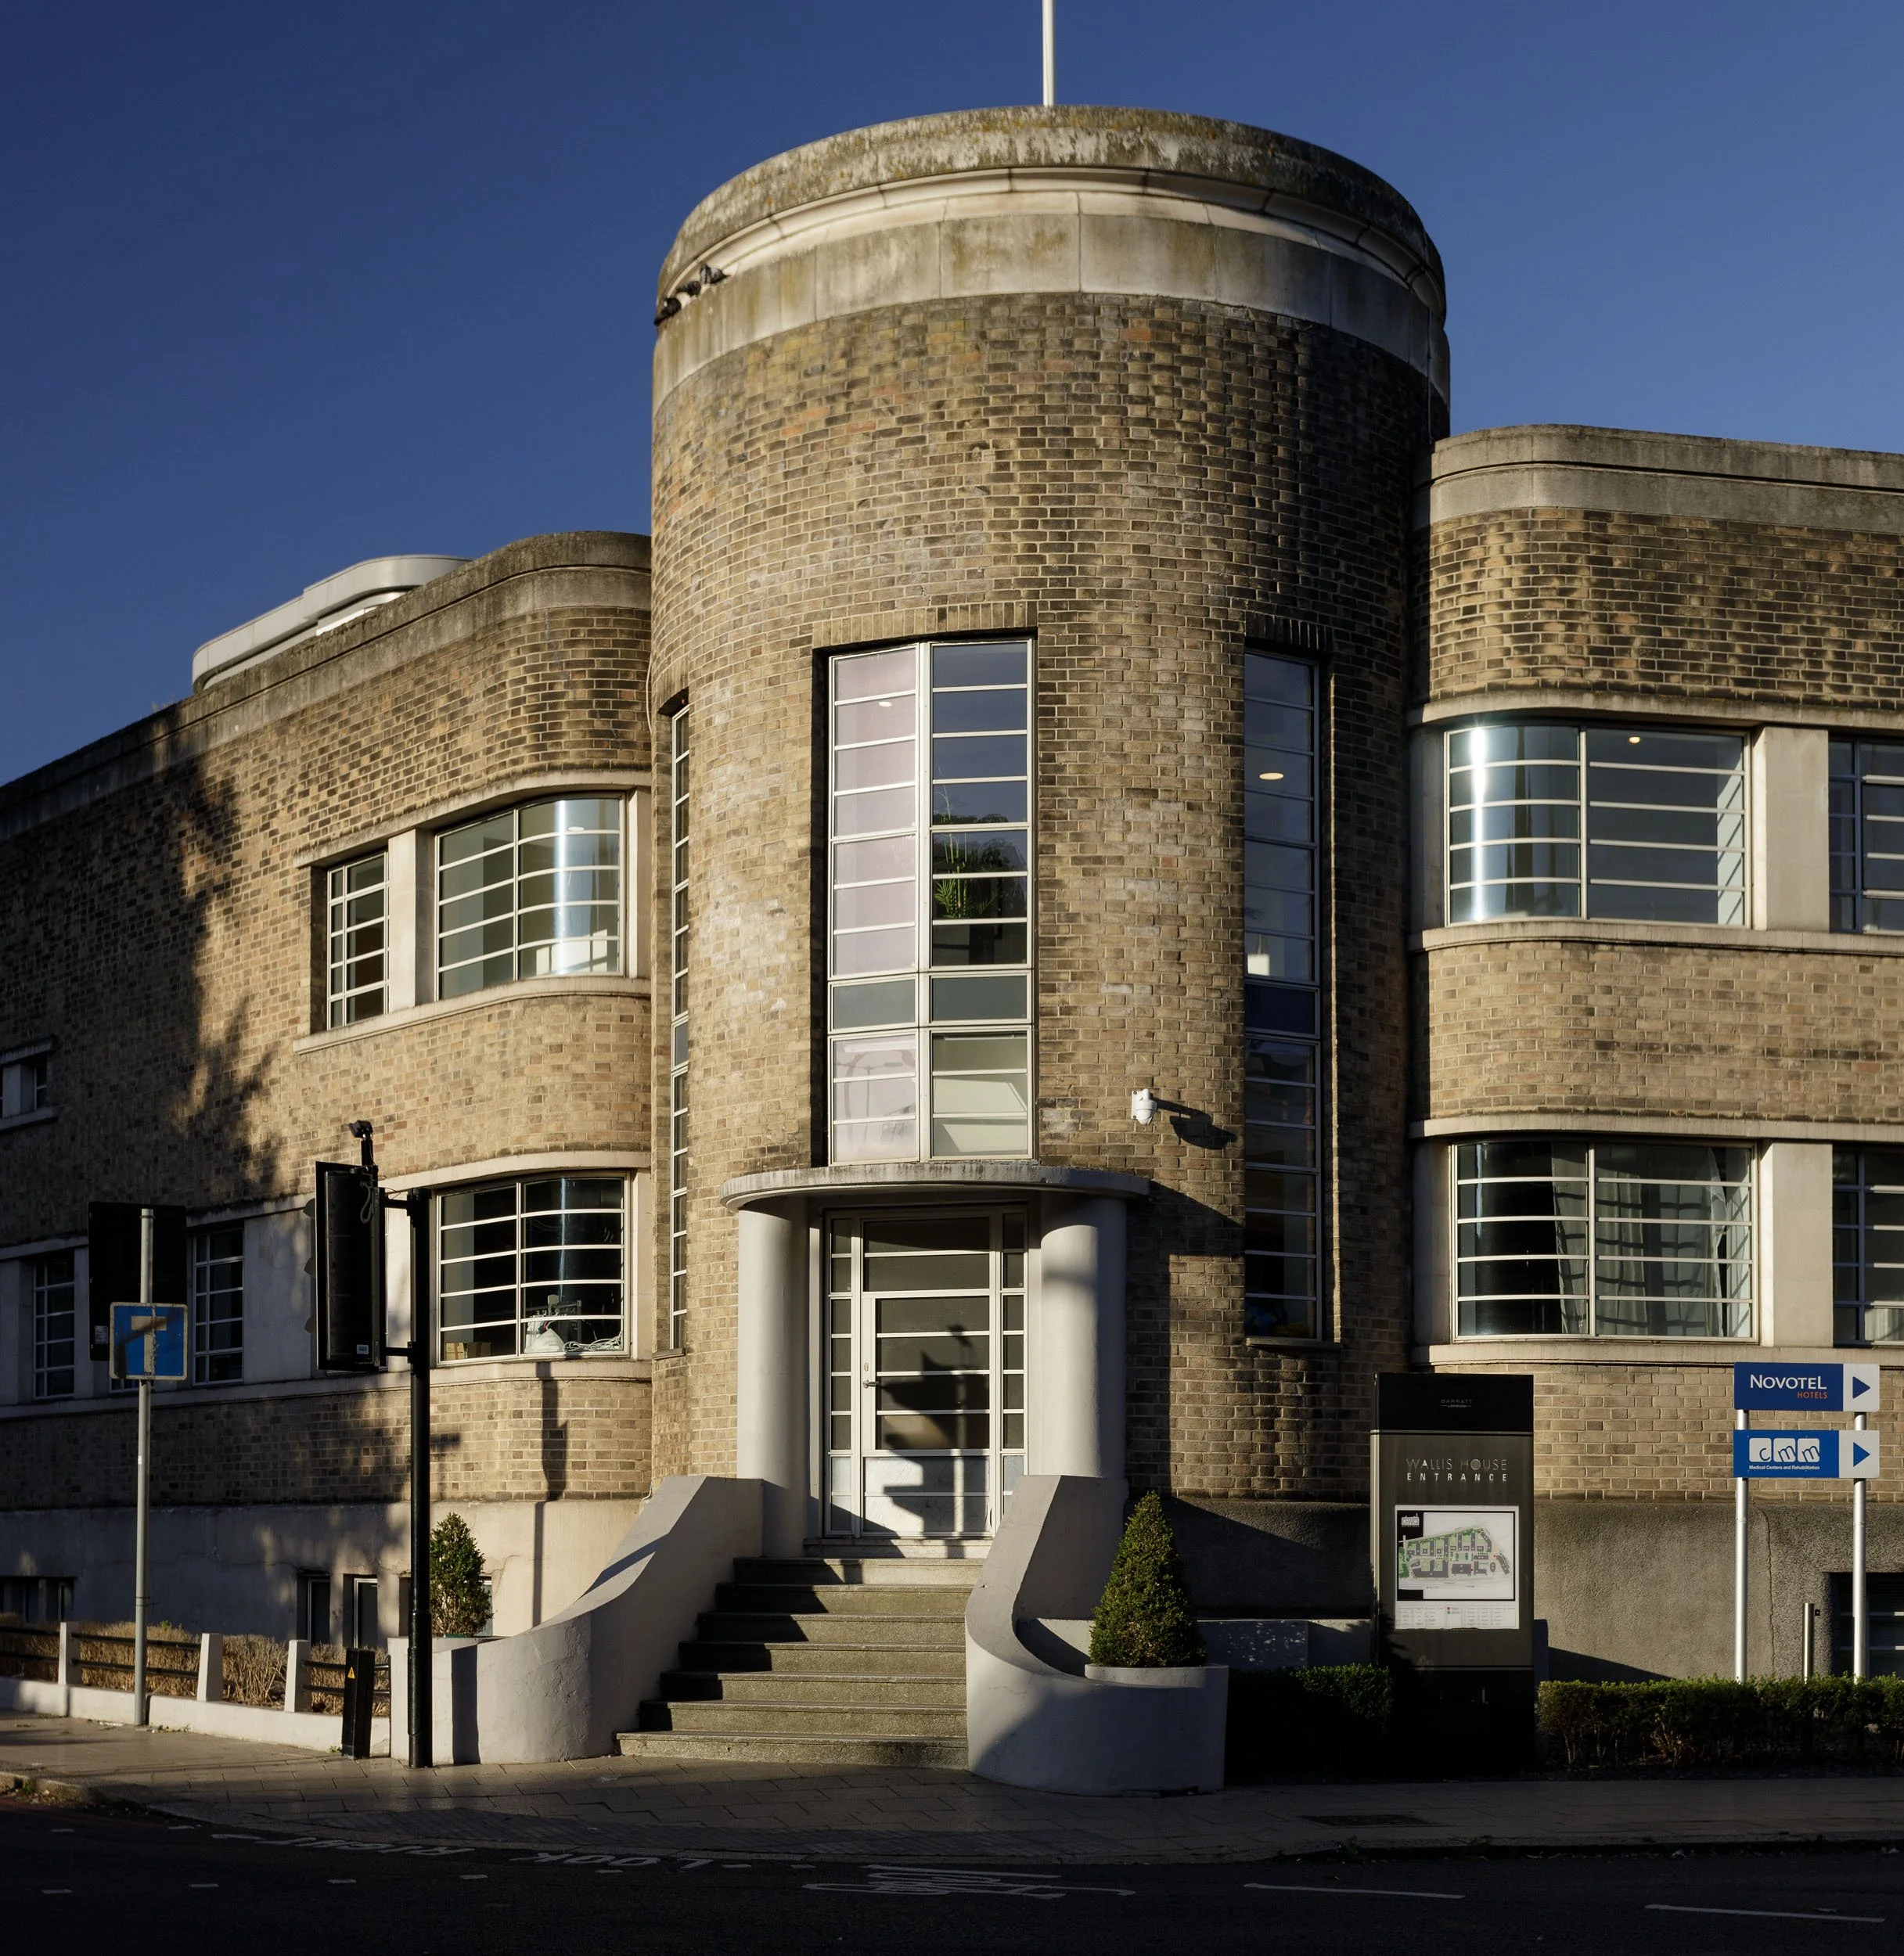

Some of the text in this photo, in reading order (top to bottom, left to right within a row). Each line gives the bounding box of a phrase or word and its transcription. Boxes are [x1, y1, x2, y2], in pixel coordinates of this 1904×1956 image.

[1750, 1374, 1827, 1390] NOVOTEL
[1406, 1458, 1507, 1471] WALLIS HOUSE
[1406, 1472, 1507, 1482] ENTRANCE
[509, 1852, 714, 1872] LOOK
